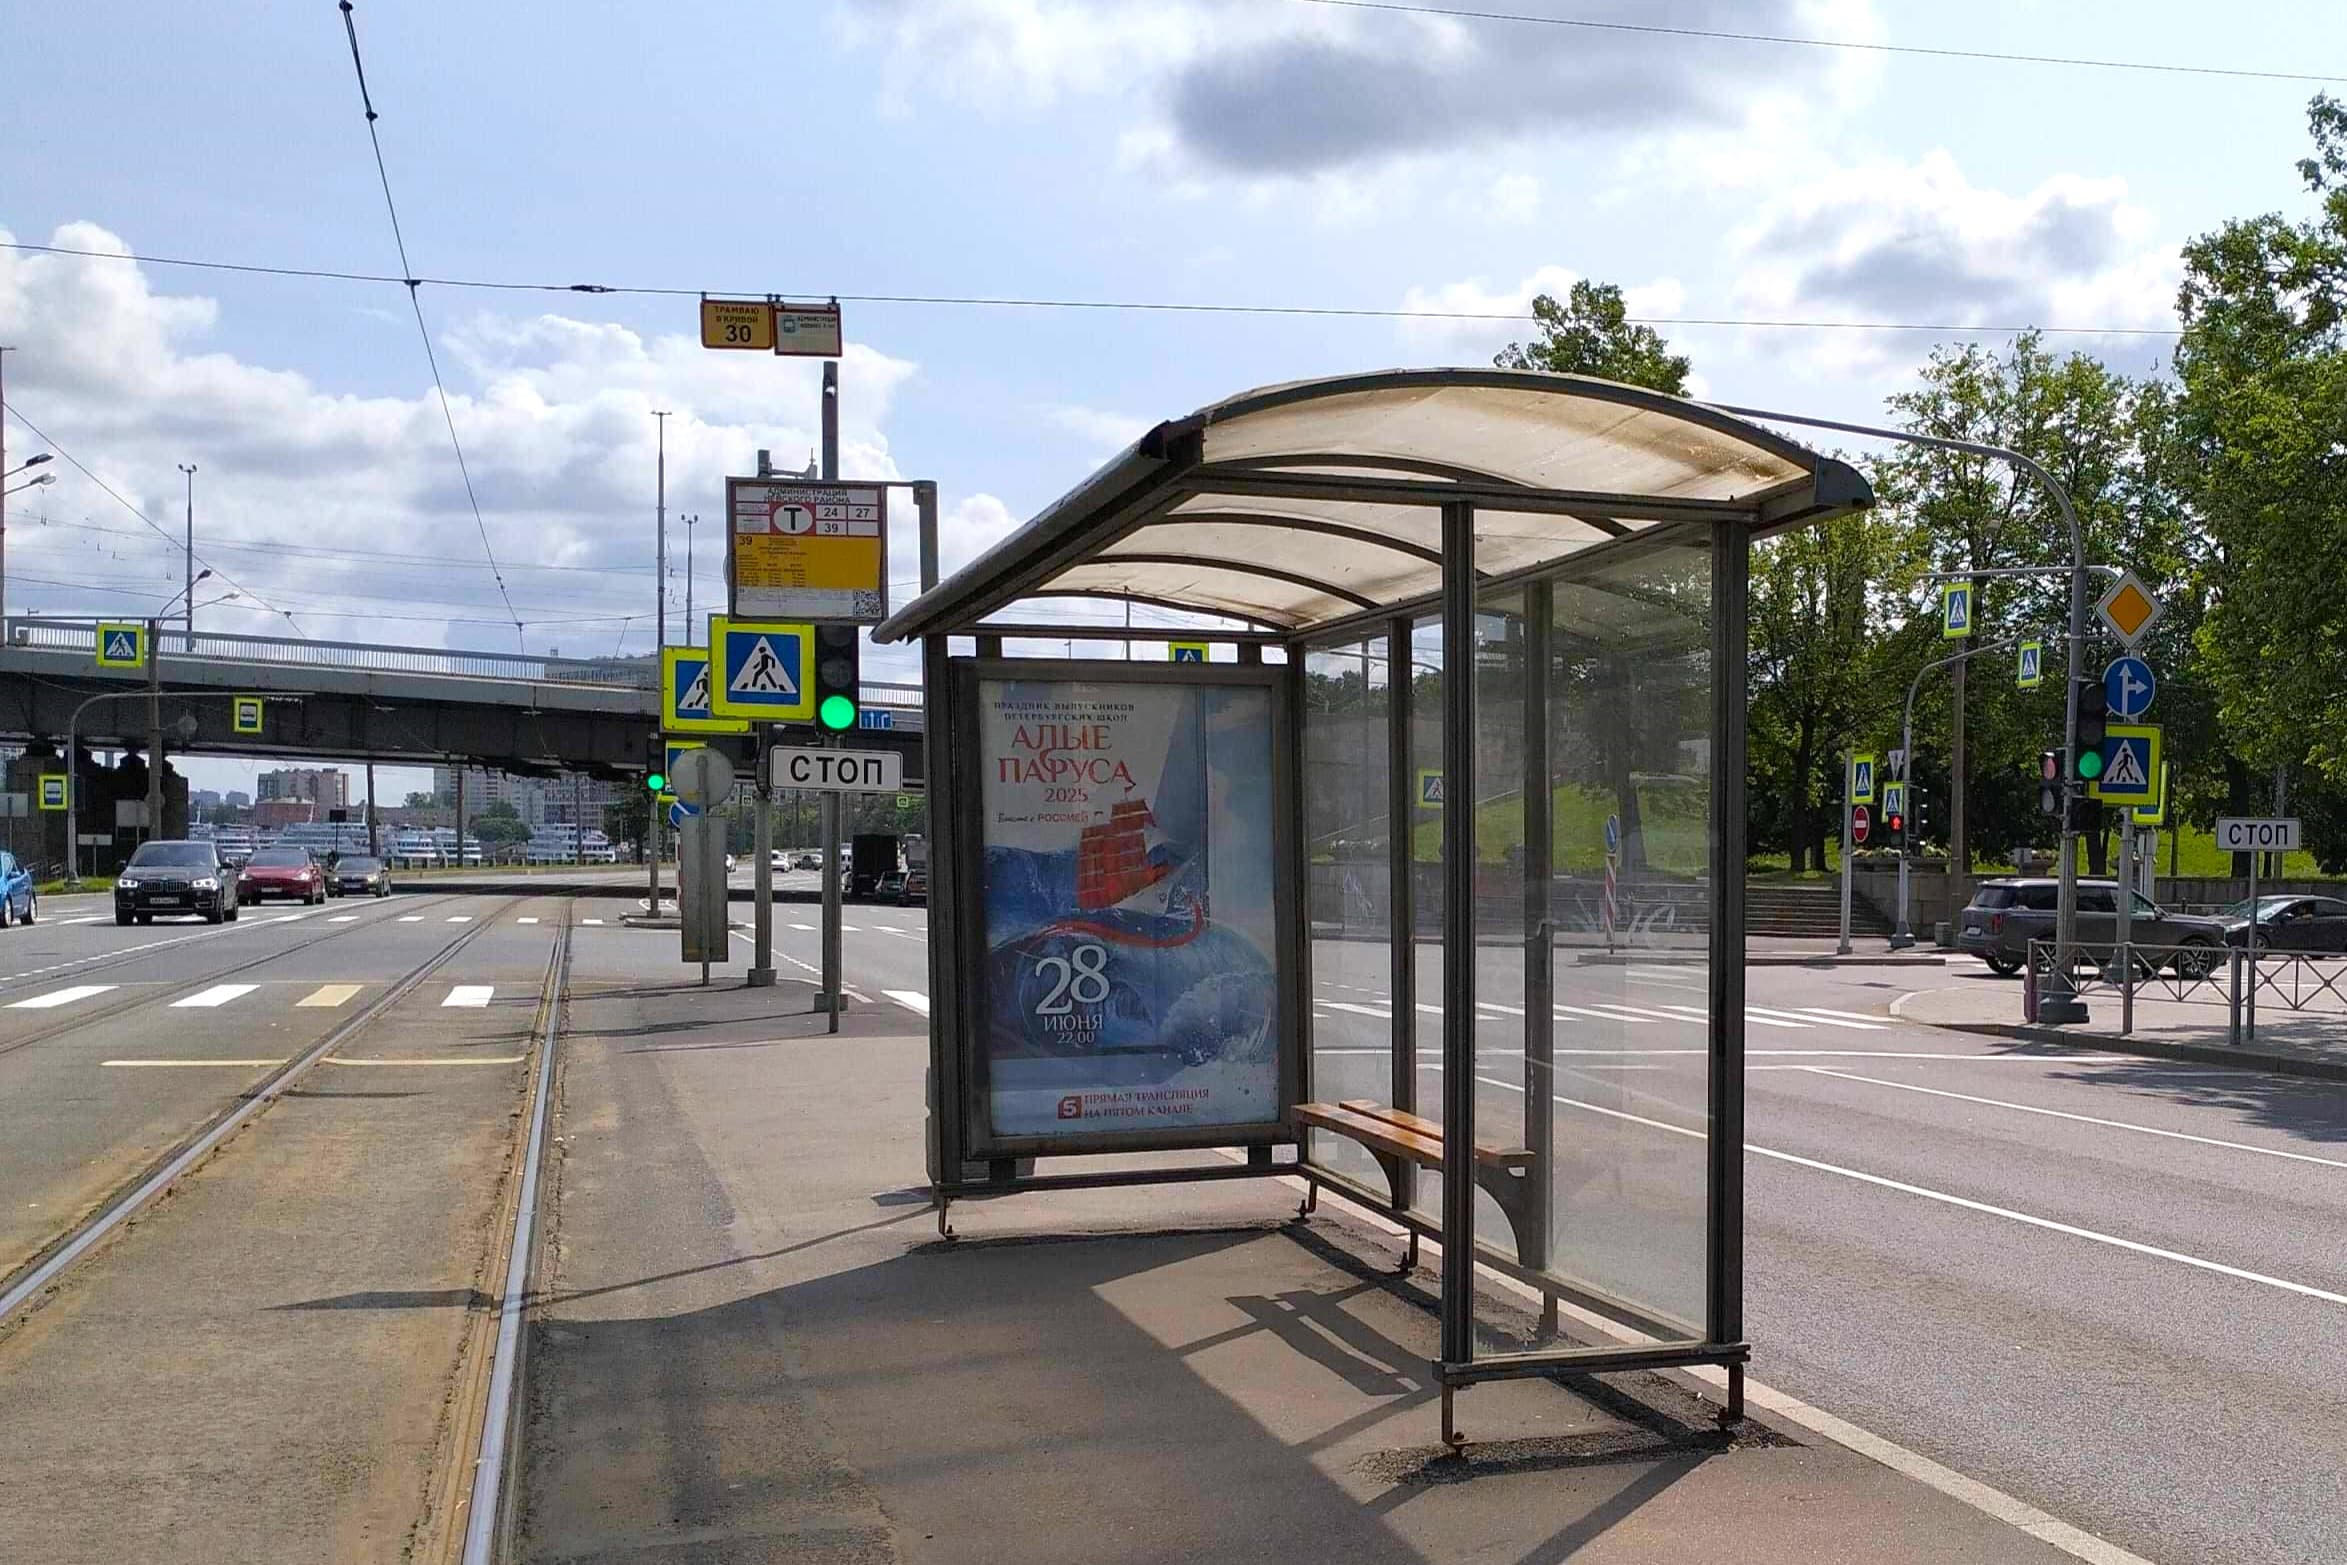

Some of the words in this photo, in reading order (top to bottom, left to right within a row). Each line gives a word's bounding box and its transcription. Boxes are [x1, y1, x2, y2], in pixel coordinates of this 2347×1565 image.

[725, 324, 752, 343] 30
[767, 487, 848, 497] АДМИНИСТРАЦИЯ
[783, 507, 803, 531] Т
[823, 507, 839, 518] 24
[855, 508, 871, 519] 27
[824, 523, 839, 533] 39
[738, 535, 753, 546] 39
[994, 701, 1049, 712] ПРАЗДНИК
[1055, 702, 1135, 712] ВЫПУСКНИКОВ
[1096, 713, 1128, 722] ШКОЛ
[1011, 724, 1113, 751] АЛЫЕ
[790, 755, 882, 785] СТОП
[998, 757, 1137, 785] ПАРУСА
[1045, 787, 1089, 803] 2025
[2228, 823, 2289, 846] СТОП
[1035, 945, 1110, 1014] 28
[1044, 1014, 1103, 1031] ИЮНЯ
[1084, 1092, 1133, 1104] ПРЯМАЯ
[1135, 1088, 1209, 1101] ТРАНСЛЯЦИЯ
[1084, 1108, 1100, 1119] НА
[1147, 1103, 1193, 1116] КАНАЛЕ
